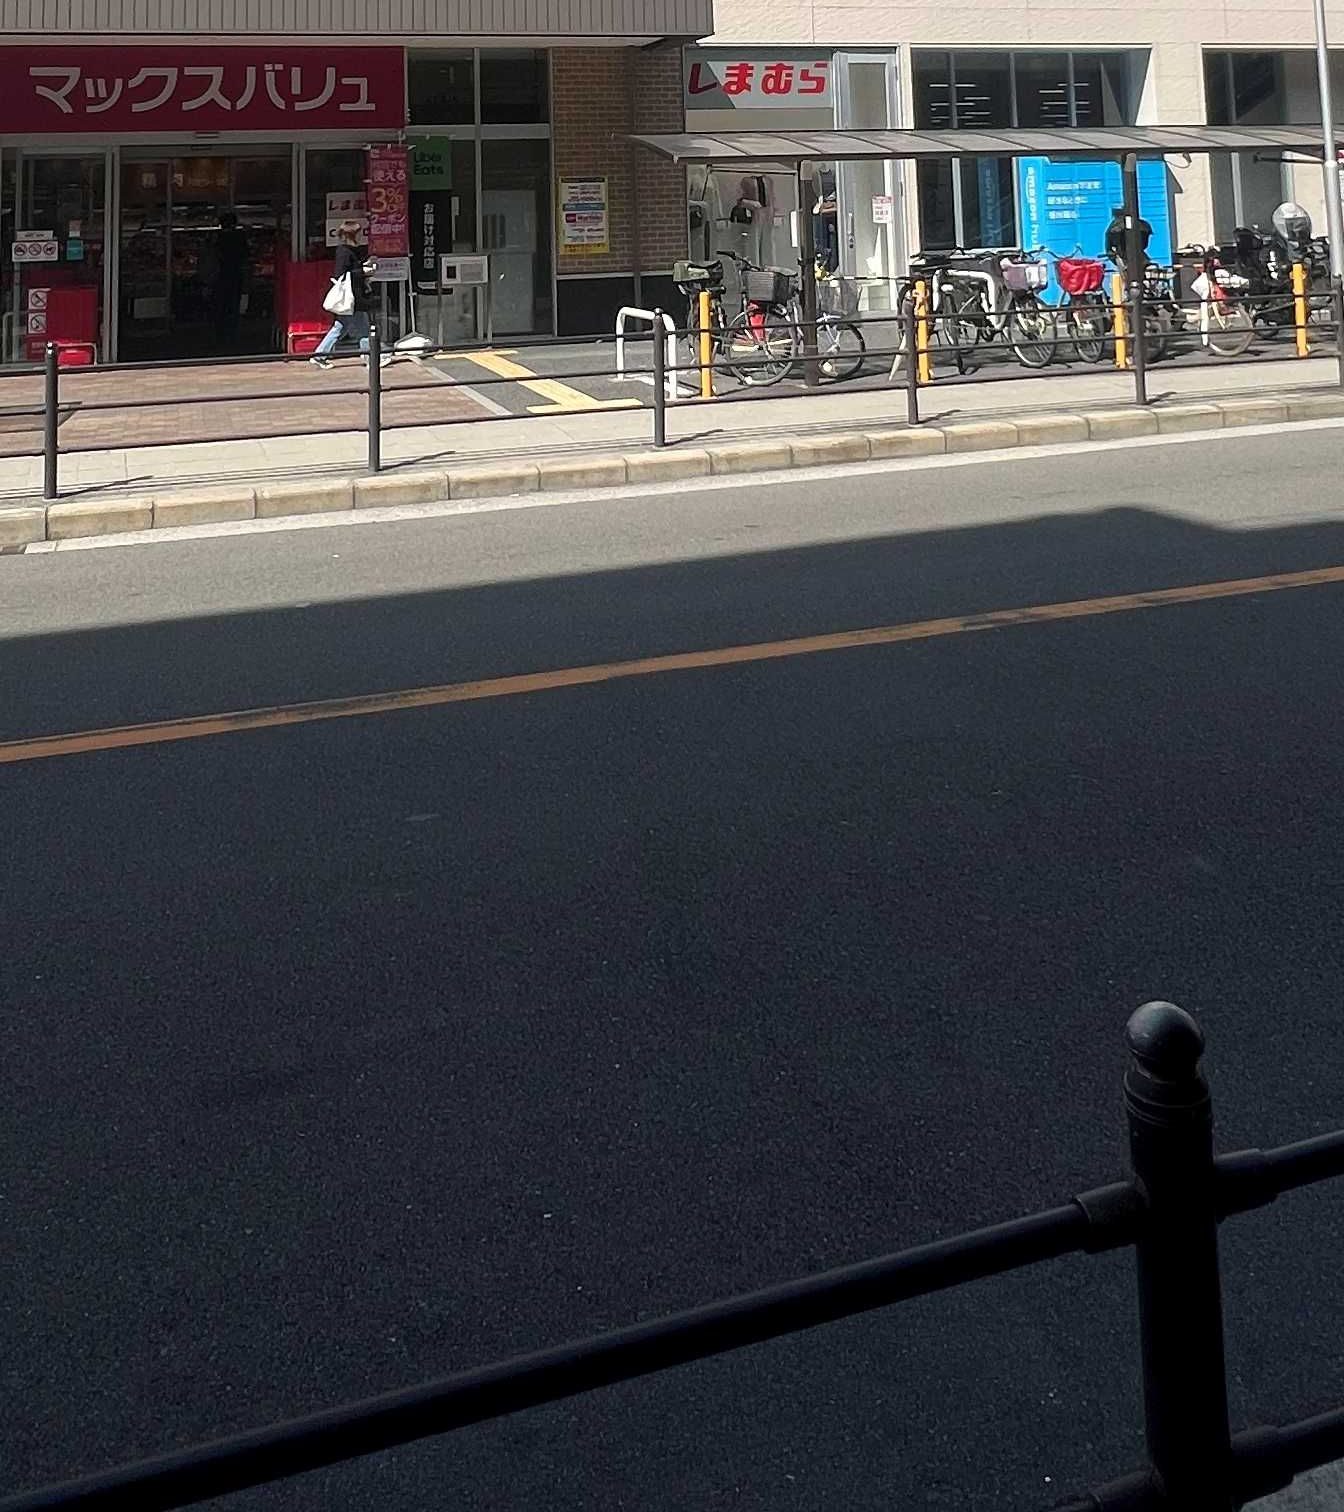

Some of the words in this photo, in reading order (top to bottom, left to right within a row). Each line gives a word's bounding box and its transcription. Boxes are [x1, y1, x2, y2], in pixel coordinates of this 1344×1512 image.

[28, 63, 377, 114] マックスバリュ
[686, 60, 829, 96] しまむら
[413, 164, 445, 176] Eats
